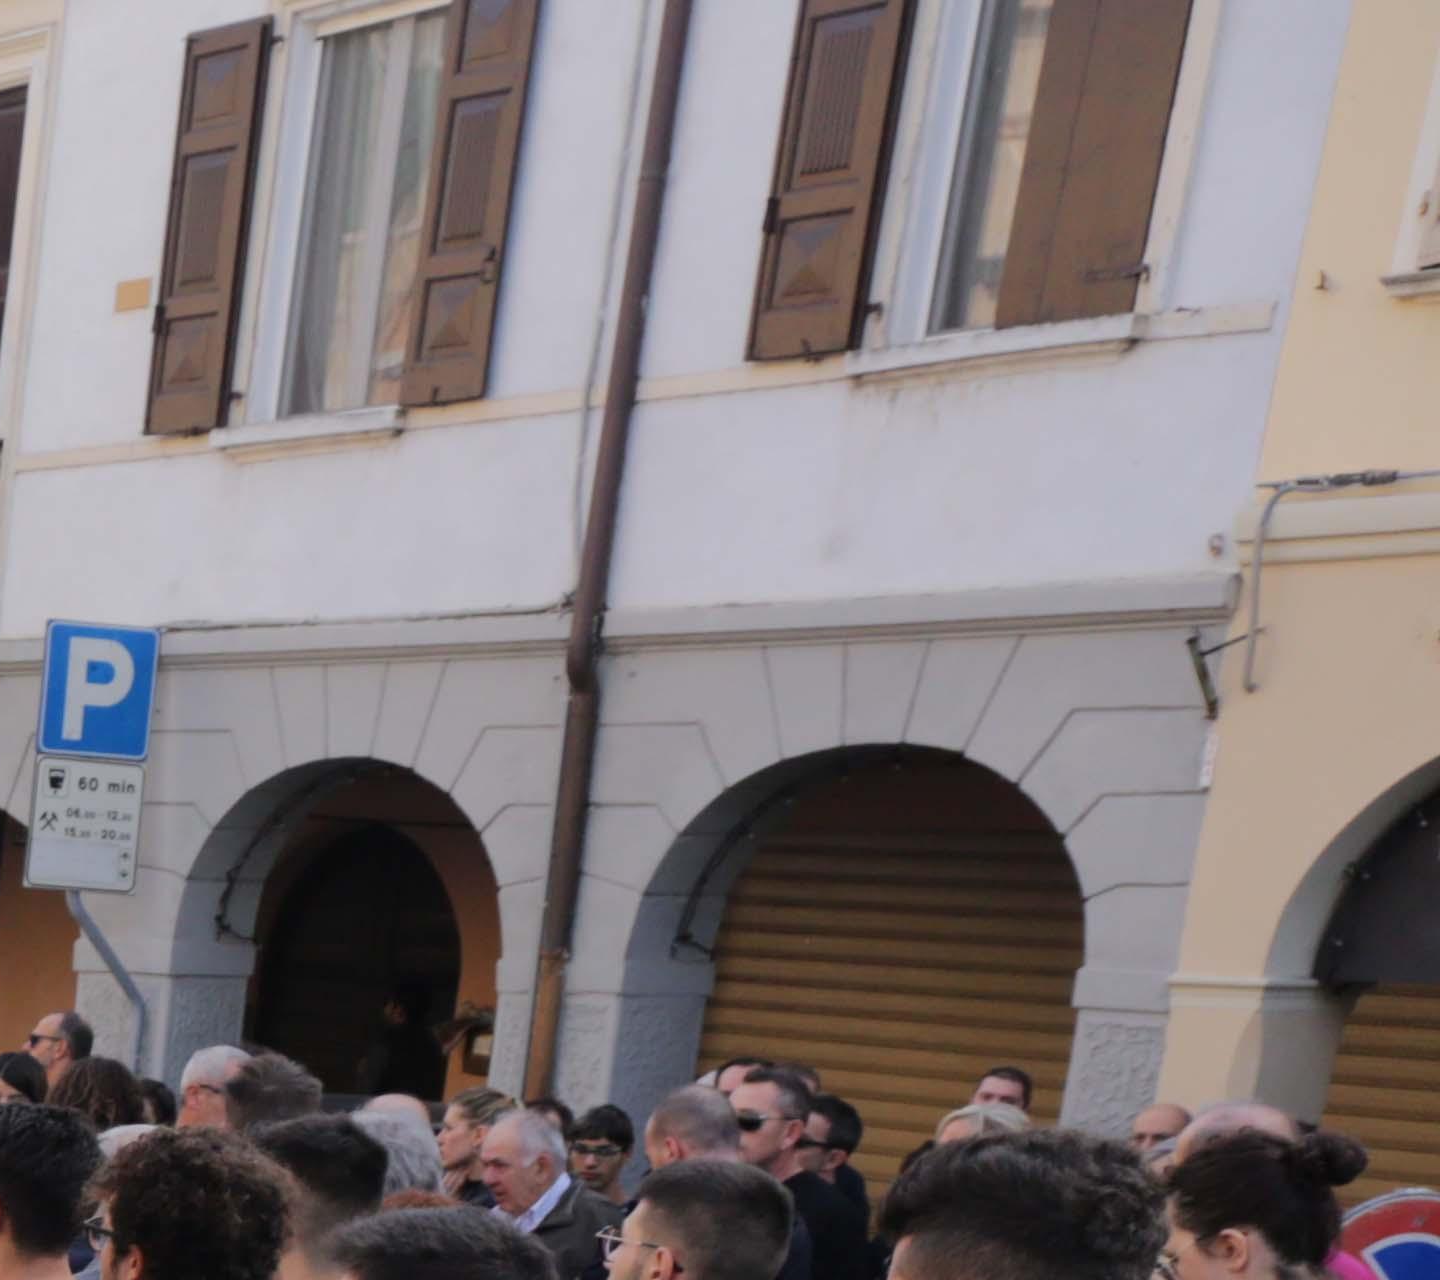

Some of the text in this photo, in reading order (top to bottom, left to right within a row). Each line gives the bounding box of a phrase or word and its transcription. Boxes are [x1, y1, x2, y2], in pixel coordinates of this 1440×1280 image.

[61, 636, 135, 741] P
[78, 776, 136, 794] 60 min
